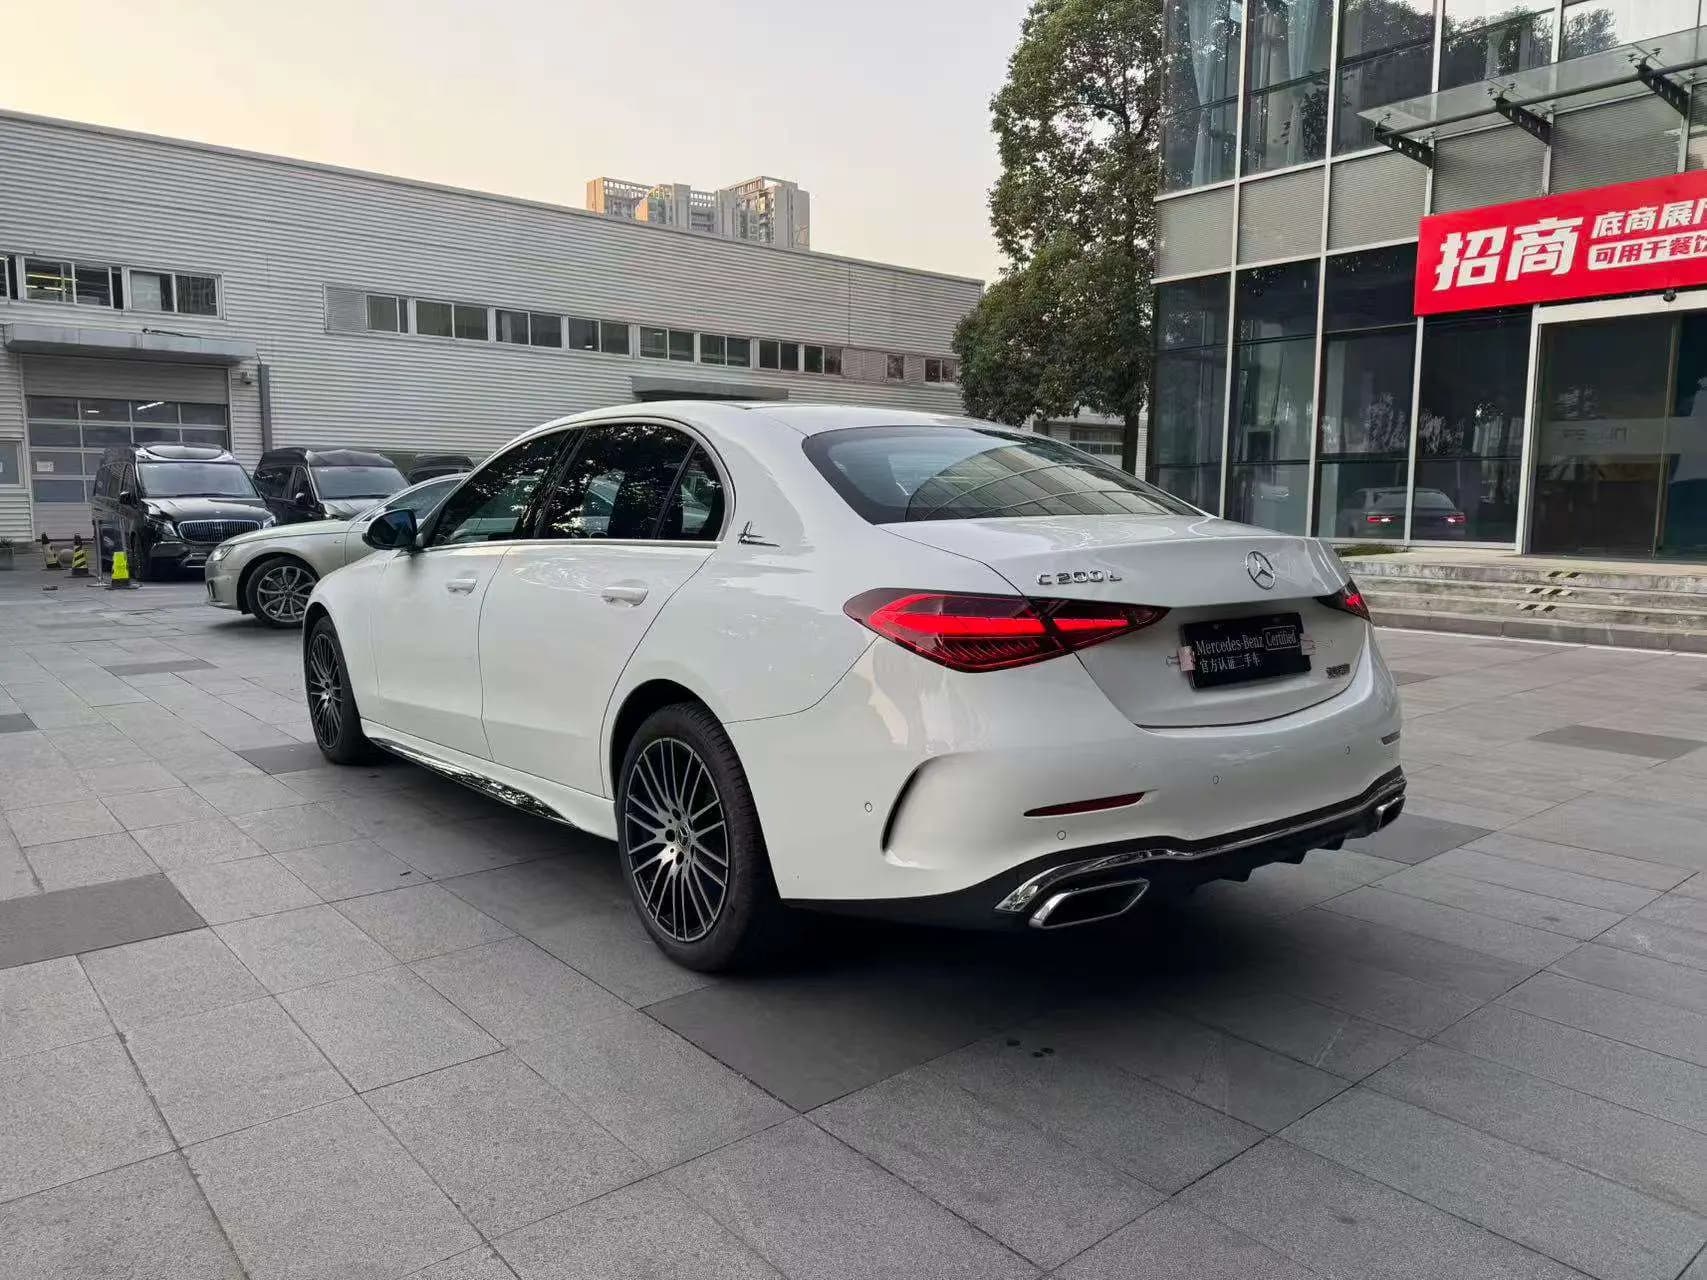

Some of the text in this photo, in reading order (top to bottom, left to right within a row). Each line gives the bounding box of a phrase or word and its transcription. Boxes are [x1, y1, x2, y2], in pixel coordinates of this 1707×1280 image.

[1432, 216, 1584, 291] 招商
[1195, 630, 1297, 656] Mercedes-Benz Certified
